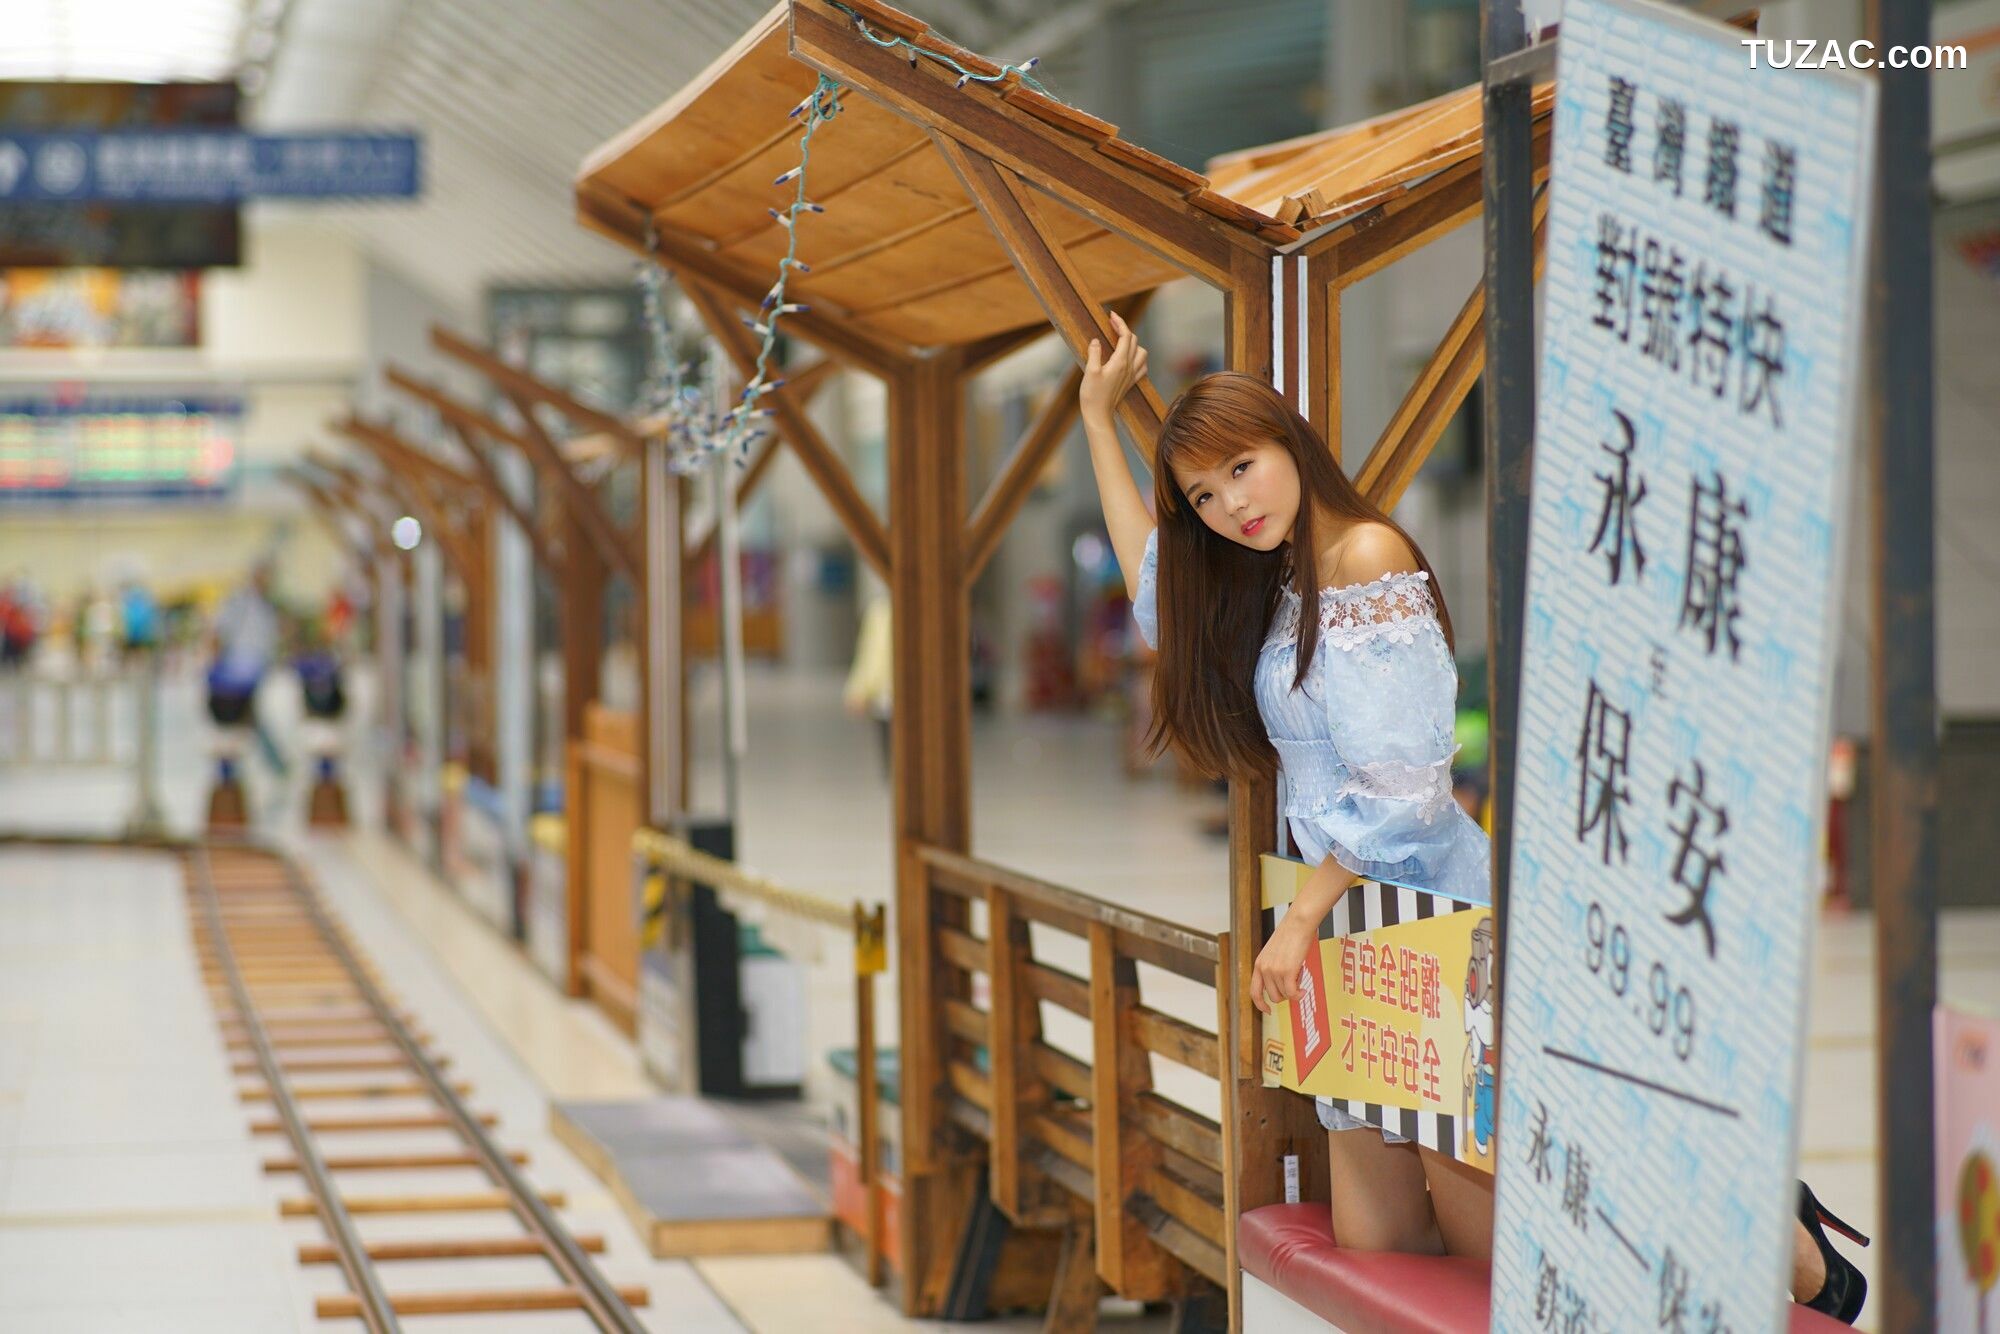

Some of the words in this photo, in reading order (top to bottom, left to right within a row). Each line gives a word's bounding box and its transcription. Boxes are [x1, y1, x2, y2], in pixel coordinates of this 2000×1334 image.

[1591, 212, 1785, 430] 對號特快
[1587, 407, 1750, 664] 永康
[1575, 677, 1731, 960] 保安
[1339, 933, 1441, 1019] 有安全距離
[1340, 1012, 1441, 1102] 才平安安全
[1585, 901, 1695, 1063] 99.99
